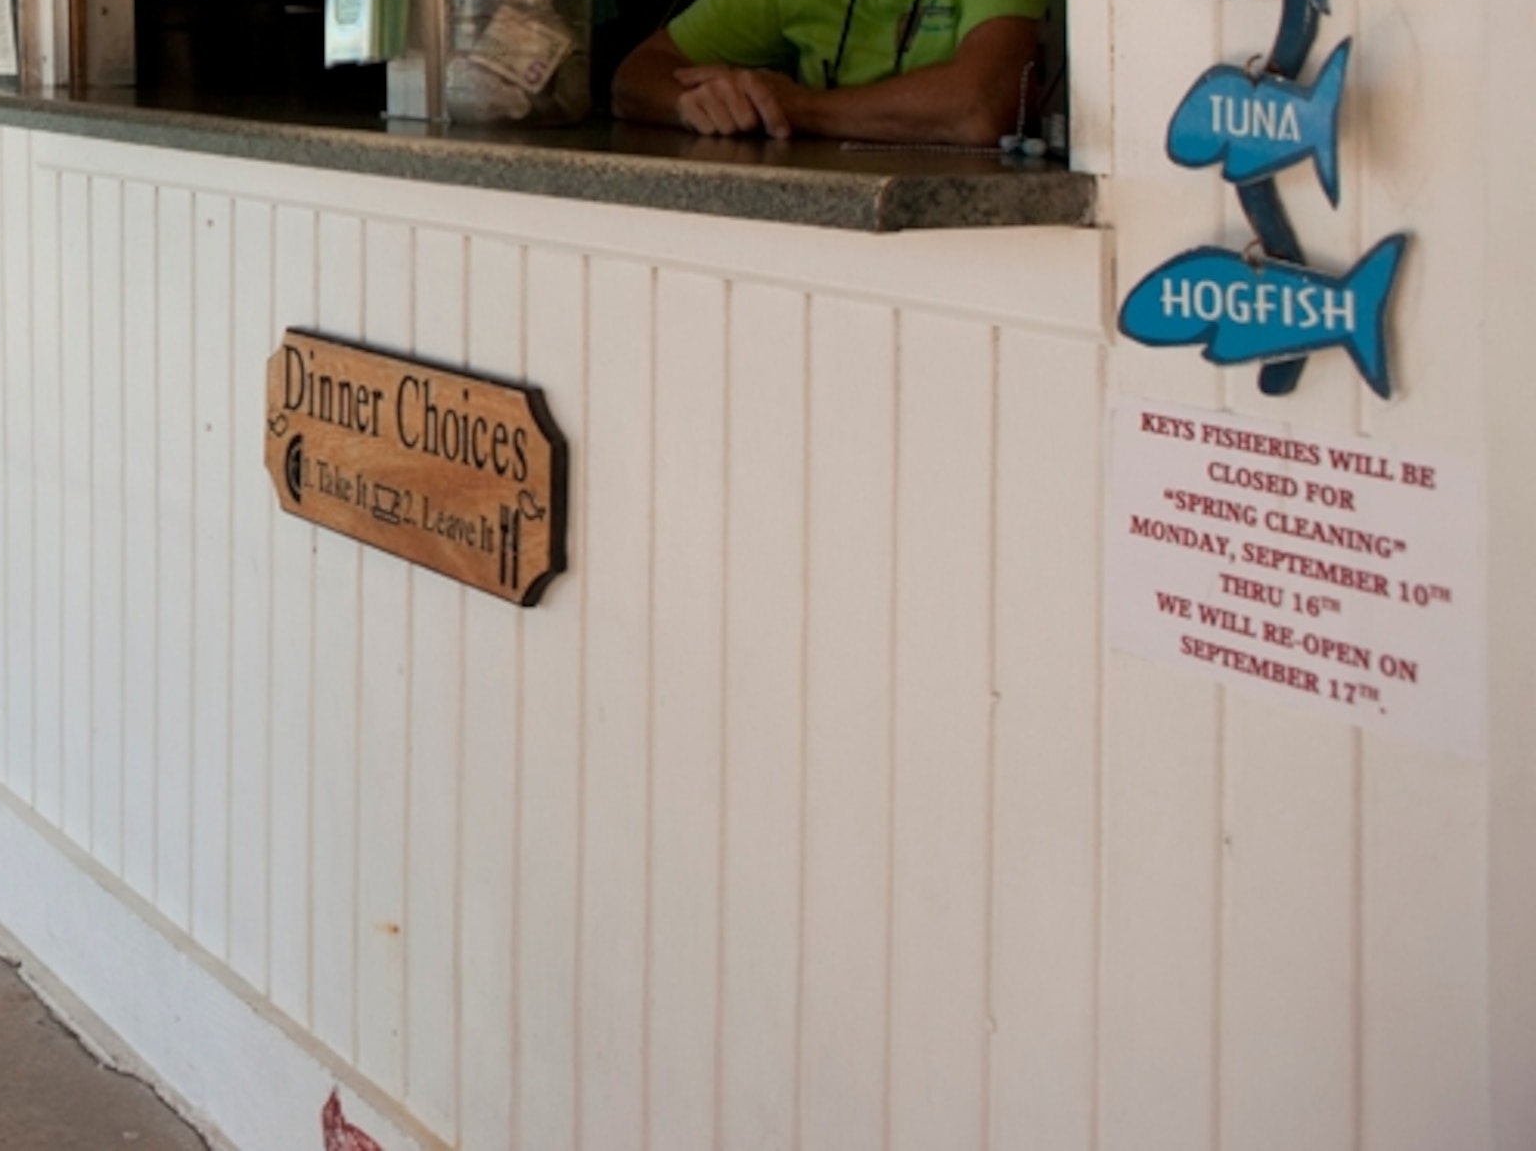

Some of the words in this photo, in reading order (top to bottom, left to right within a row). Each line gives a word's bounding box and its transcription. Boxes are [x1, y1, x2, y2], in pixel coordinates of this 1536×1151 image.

[1208, 94, 1302, 143] TUNA
[1160, 277, 1357, 332] HOGFISH
[282, 344, 384, 437] Dinner
[396, 375, 528, 483] Choices
[1141, 412, 1195, 441] KEYS
[1201, 423, 1321, 466] FISHERIES
[1327, 448, 1394, 481] WILL
[1401, 462, 1438, 490] BE
[316, 459, 352, 503] Take
[422, 496, 477, 547] Leave
[1207, 461, 1298, 498] CLOSED
[1305, 481, 1356, 511] FOR
[1130, 515, 1237, 564] MONDAY,
[1241, 543, 1390, 598] SEPTEMBER
[1398, 581, 1452, 607] 10TH
[1219, 573, 1284, 608] THRU
[1292, 592, 1342, 618] 16TH
[1155, 592, 1193, 620] WE
[1198, 603, 1257, 637] WILL
[1262, 621, 1372, 670] RE-OPEN
[1379, 654, 1420, 684] ON
[1180, 635, 1320, 695] SEPTEMBER
